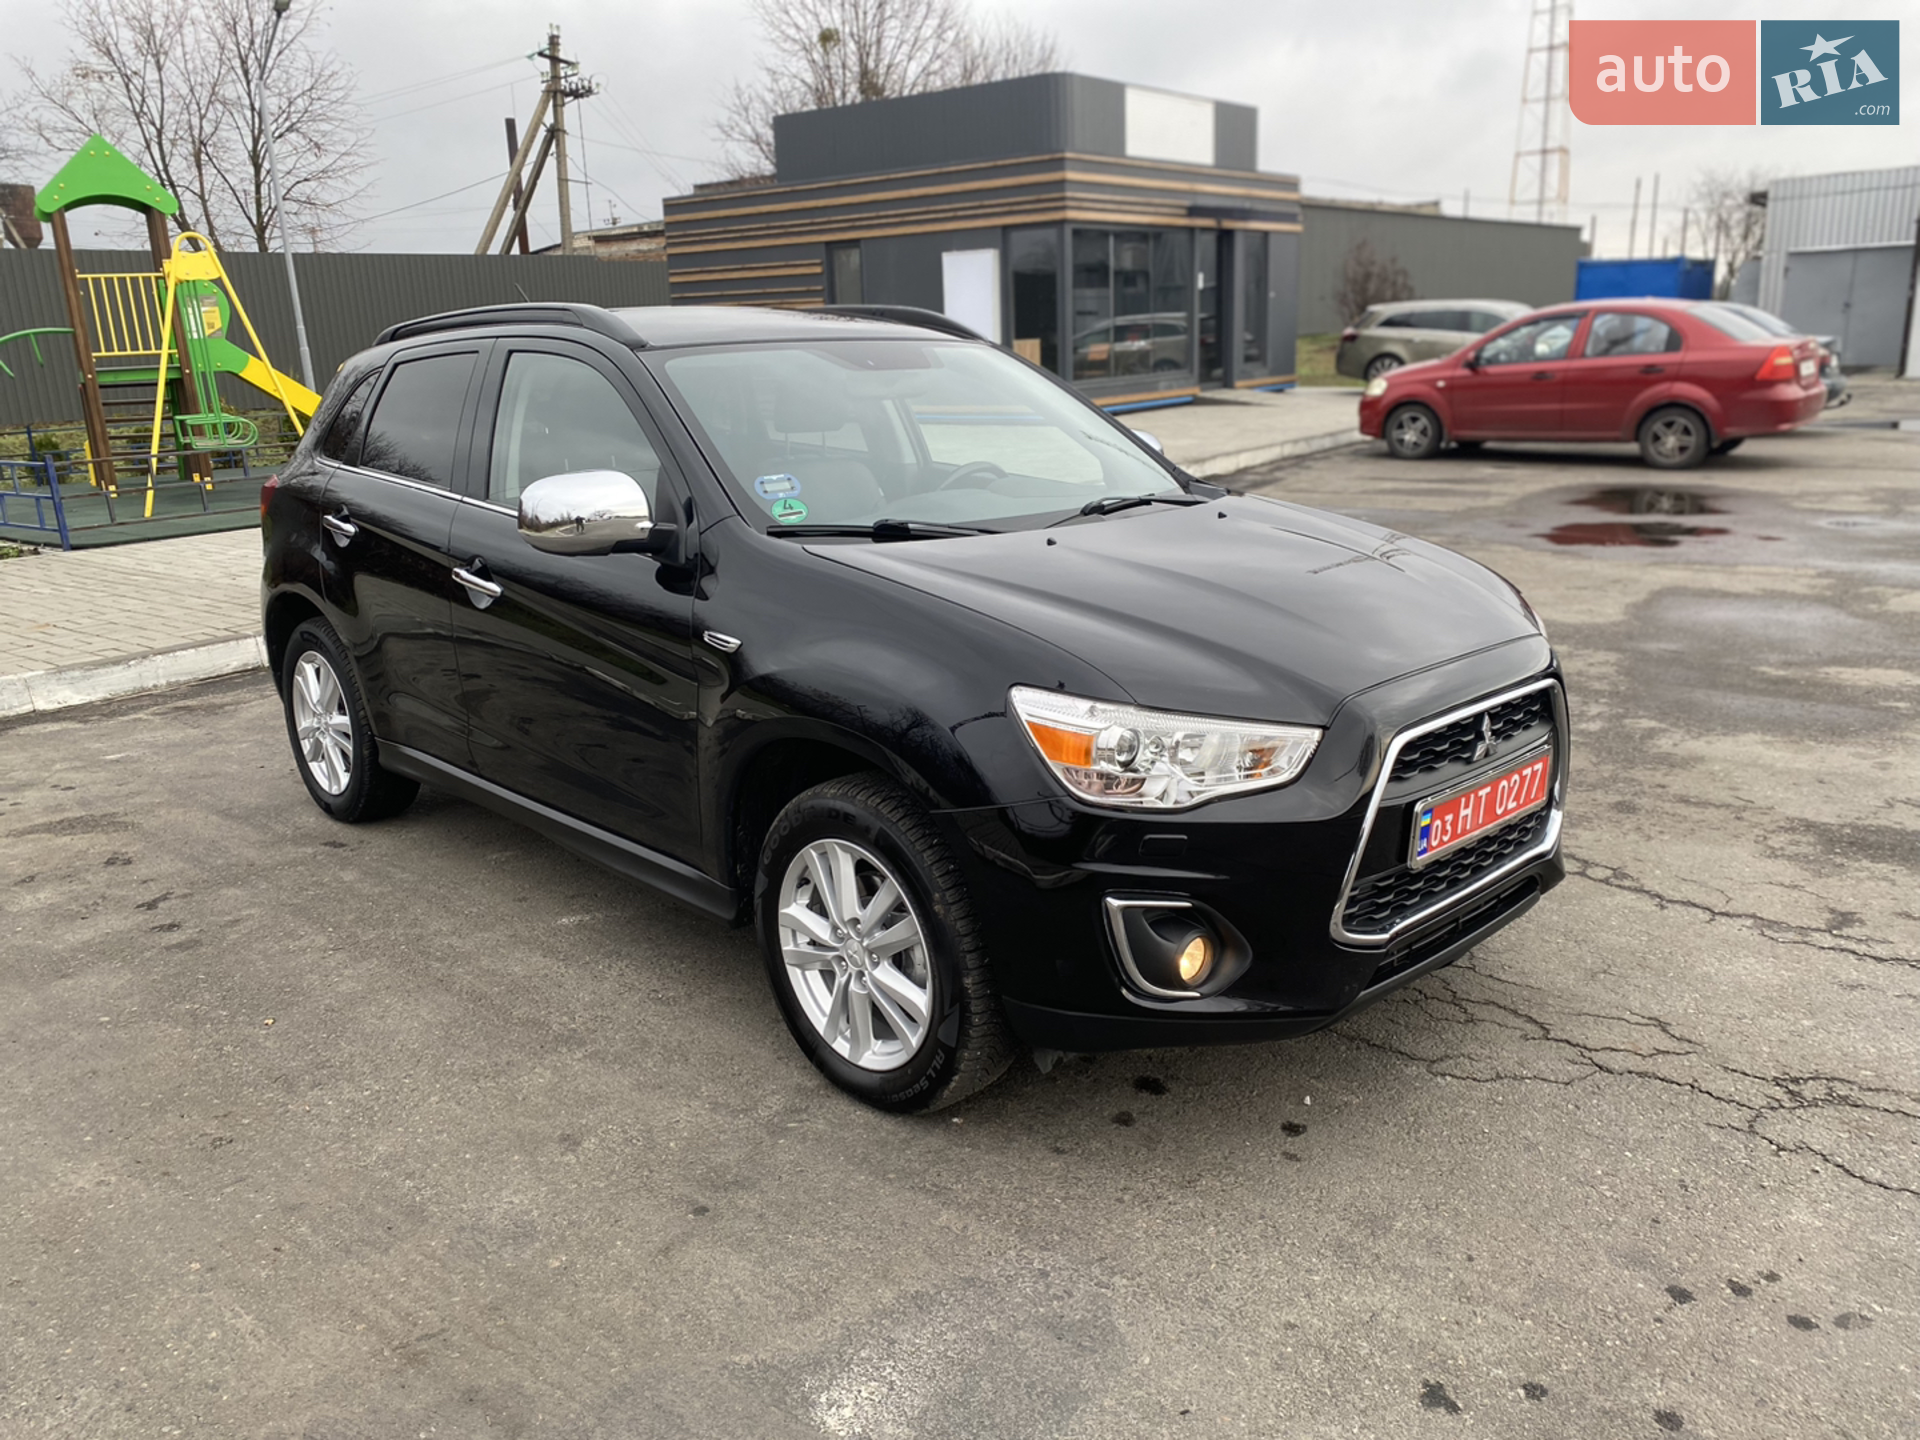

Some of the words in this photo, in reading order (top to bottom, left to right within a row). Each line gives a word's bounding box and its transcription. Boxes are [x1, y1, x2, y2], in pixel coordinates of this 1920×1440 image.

[782, 499, 794, 511] 4
[1431, 813, 1454, 847] 03
[1457, 786, 1492, 834] HT
[1495, 762, 1544, 815] 0277
[763, 807, 858, 866] GOODRDE
[1418, 838, 1428, 851] UA
